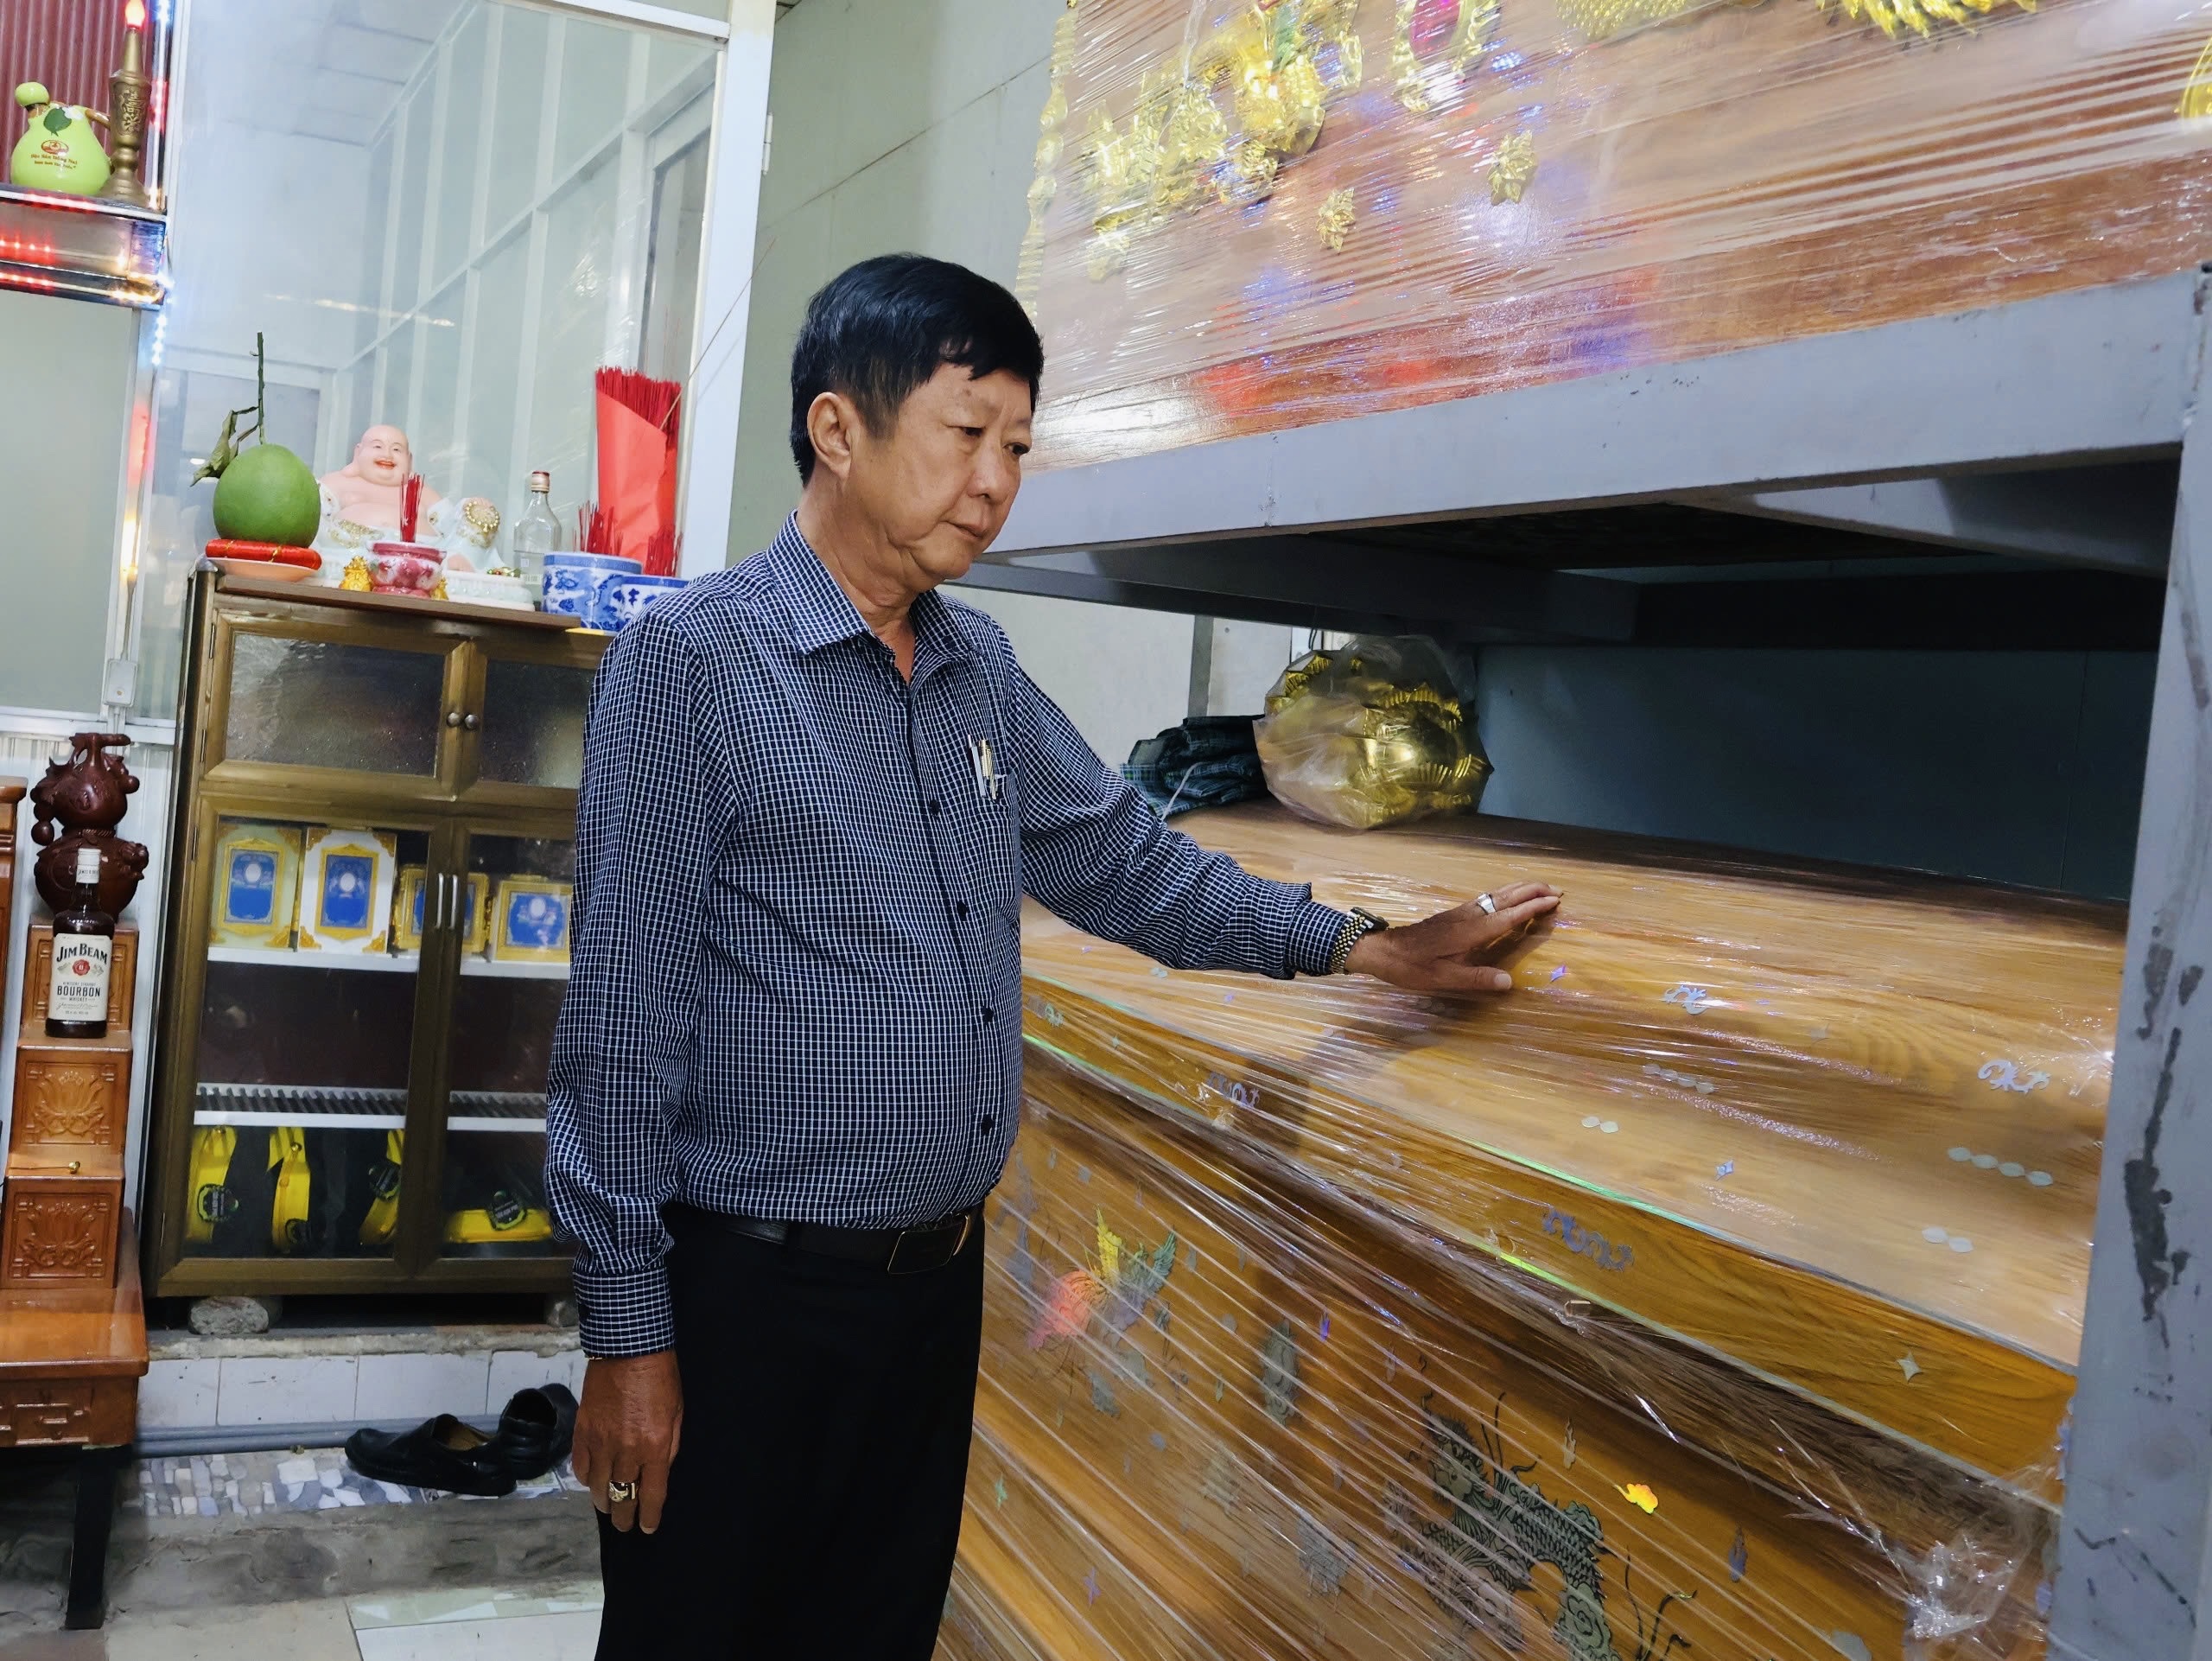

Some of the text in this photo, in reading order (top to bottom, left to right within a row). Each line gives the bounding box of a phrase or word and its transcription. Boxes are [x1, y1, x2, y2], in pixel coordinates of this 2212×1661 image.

[56, 943, 108, 964] JIM BEAM
[57, 985, 101, 997] BOURBON
